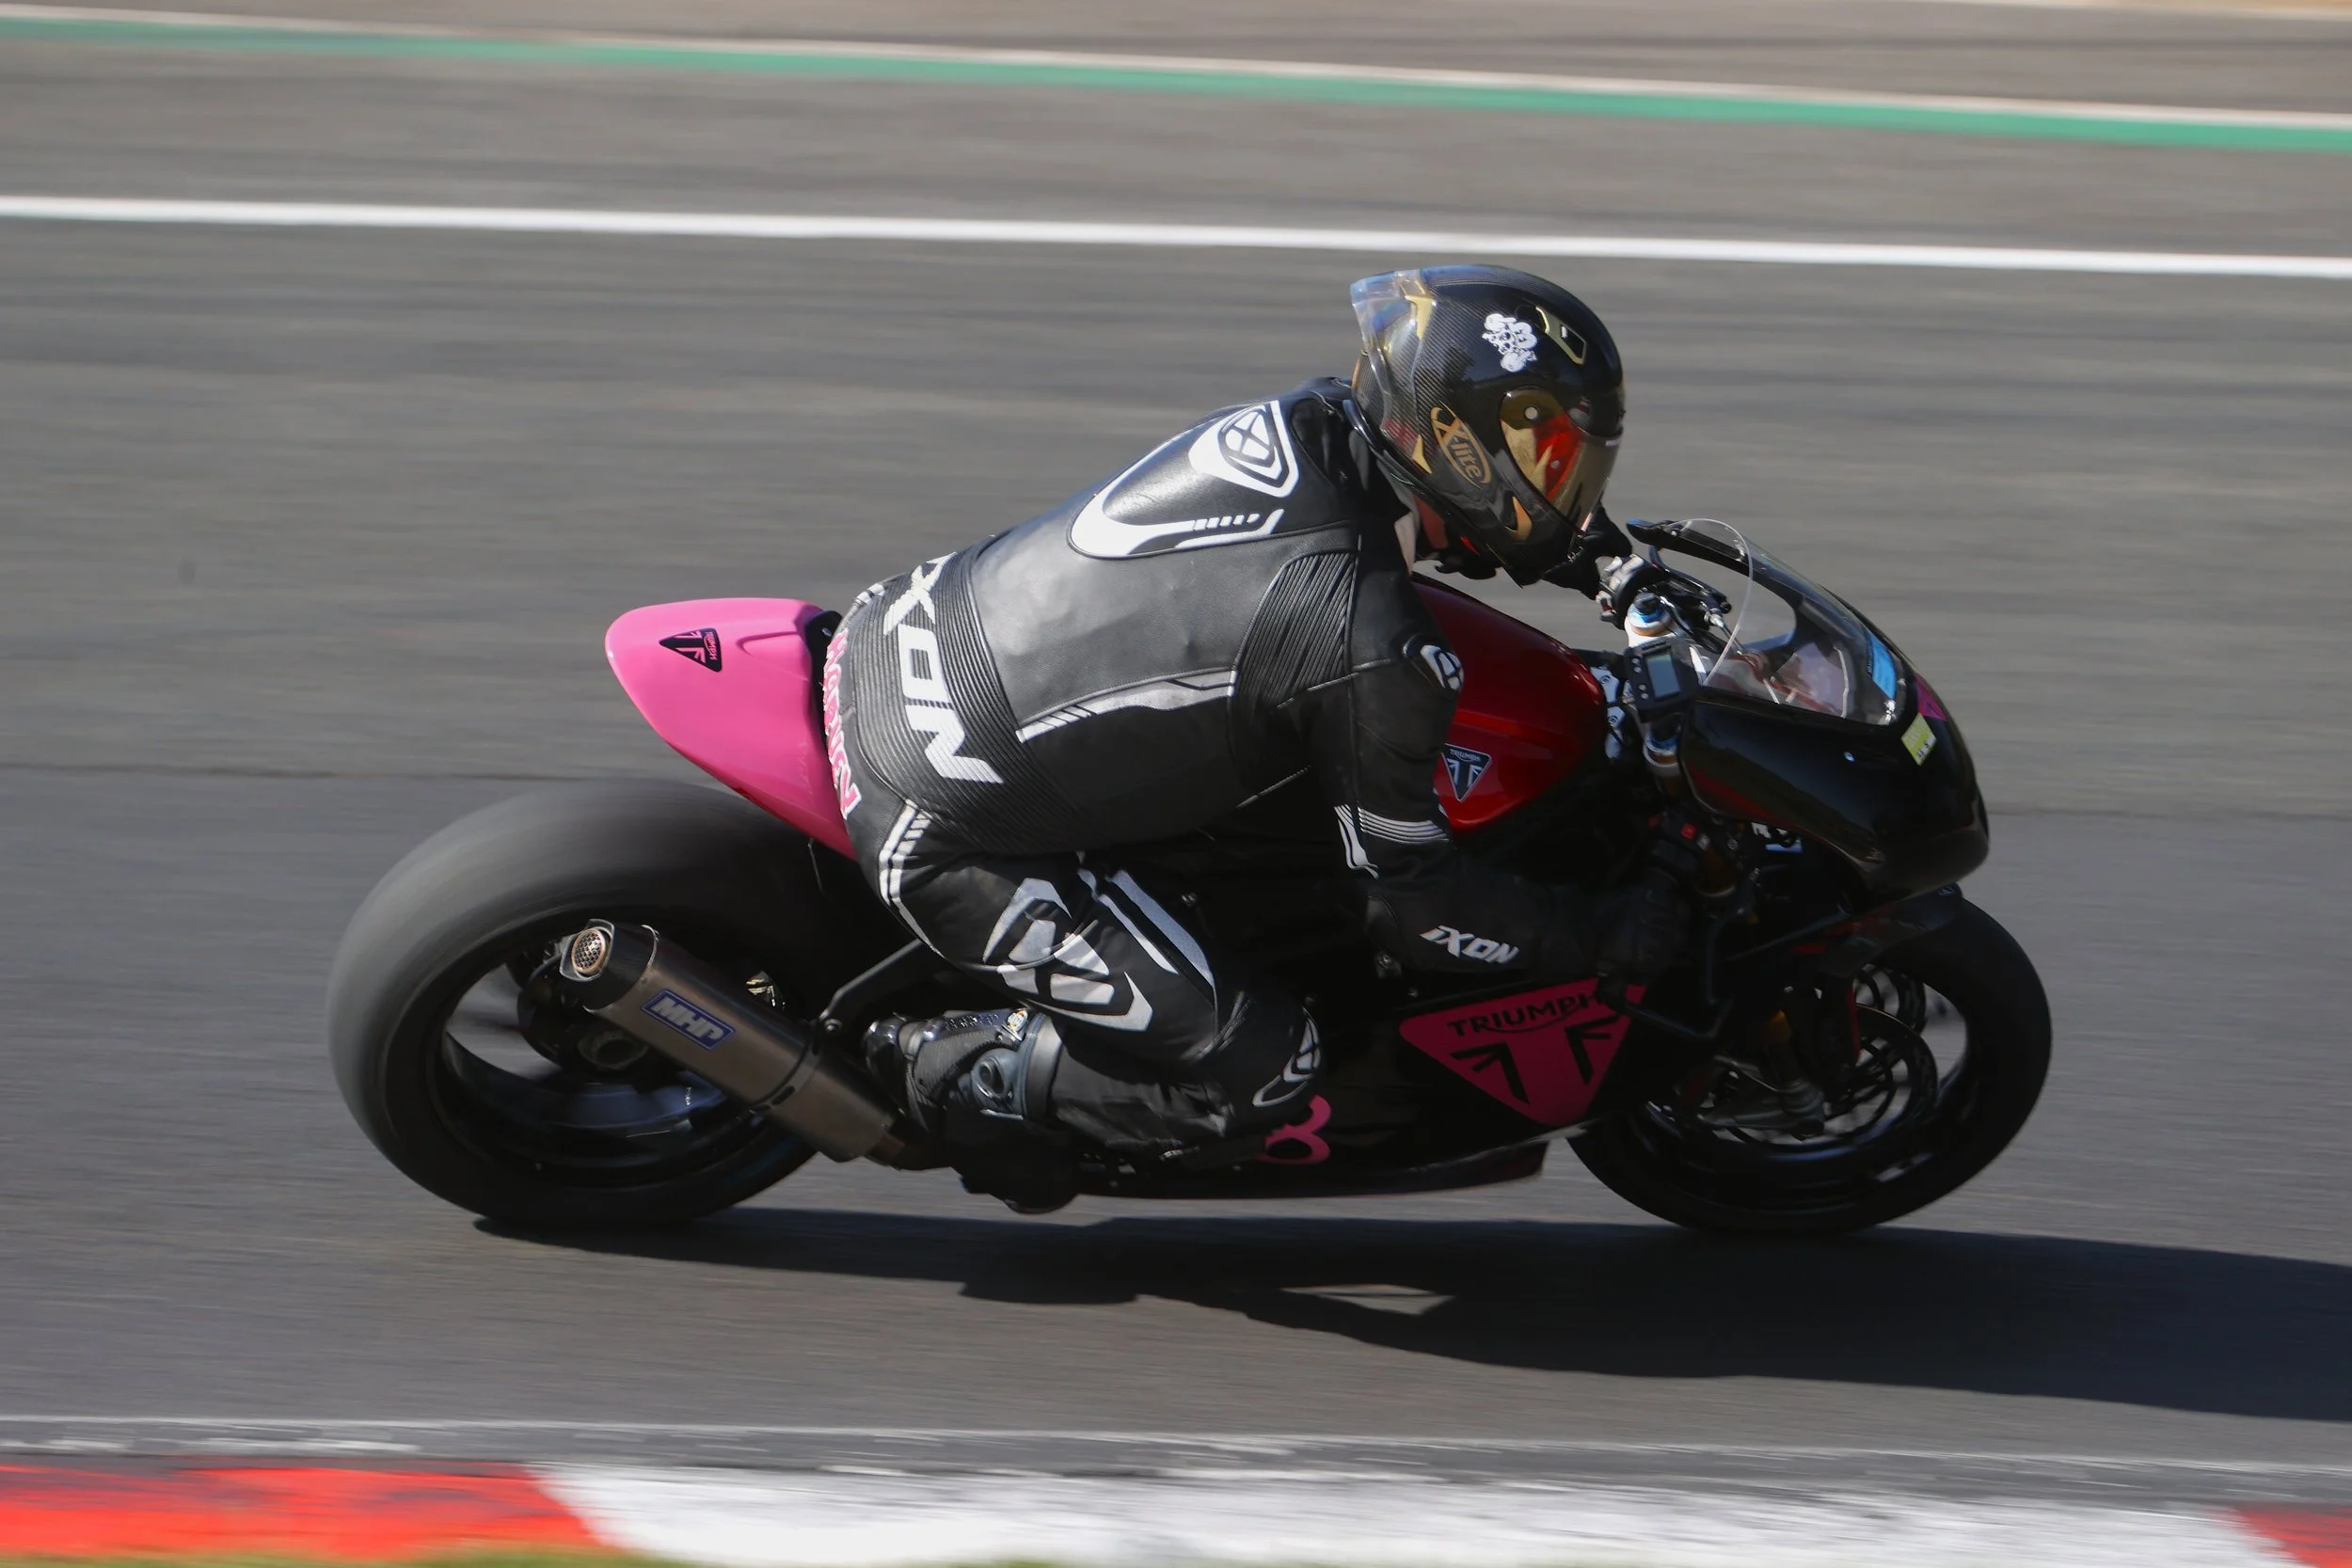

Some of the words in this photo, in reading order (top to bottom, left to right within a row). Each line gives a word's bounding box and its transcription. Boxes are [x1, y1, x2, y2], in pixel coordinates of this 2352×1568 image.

[883, 551, 1004, 784] XON
[1419, 925, 1519, 964] IXON
[650, 996, 723, 1039] MHP
